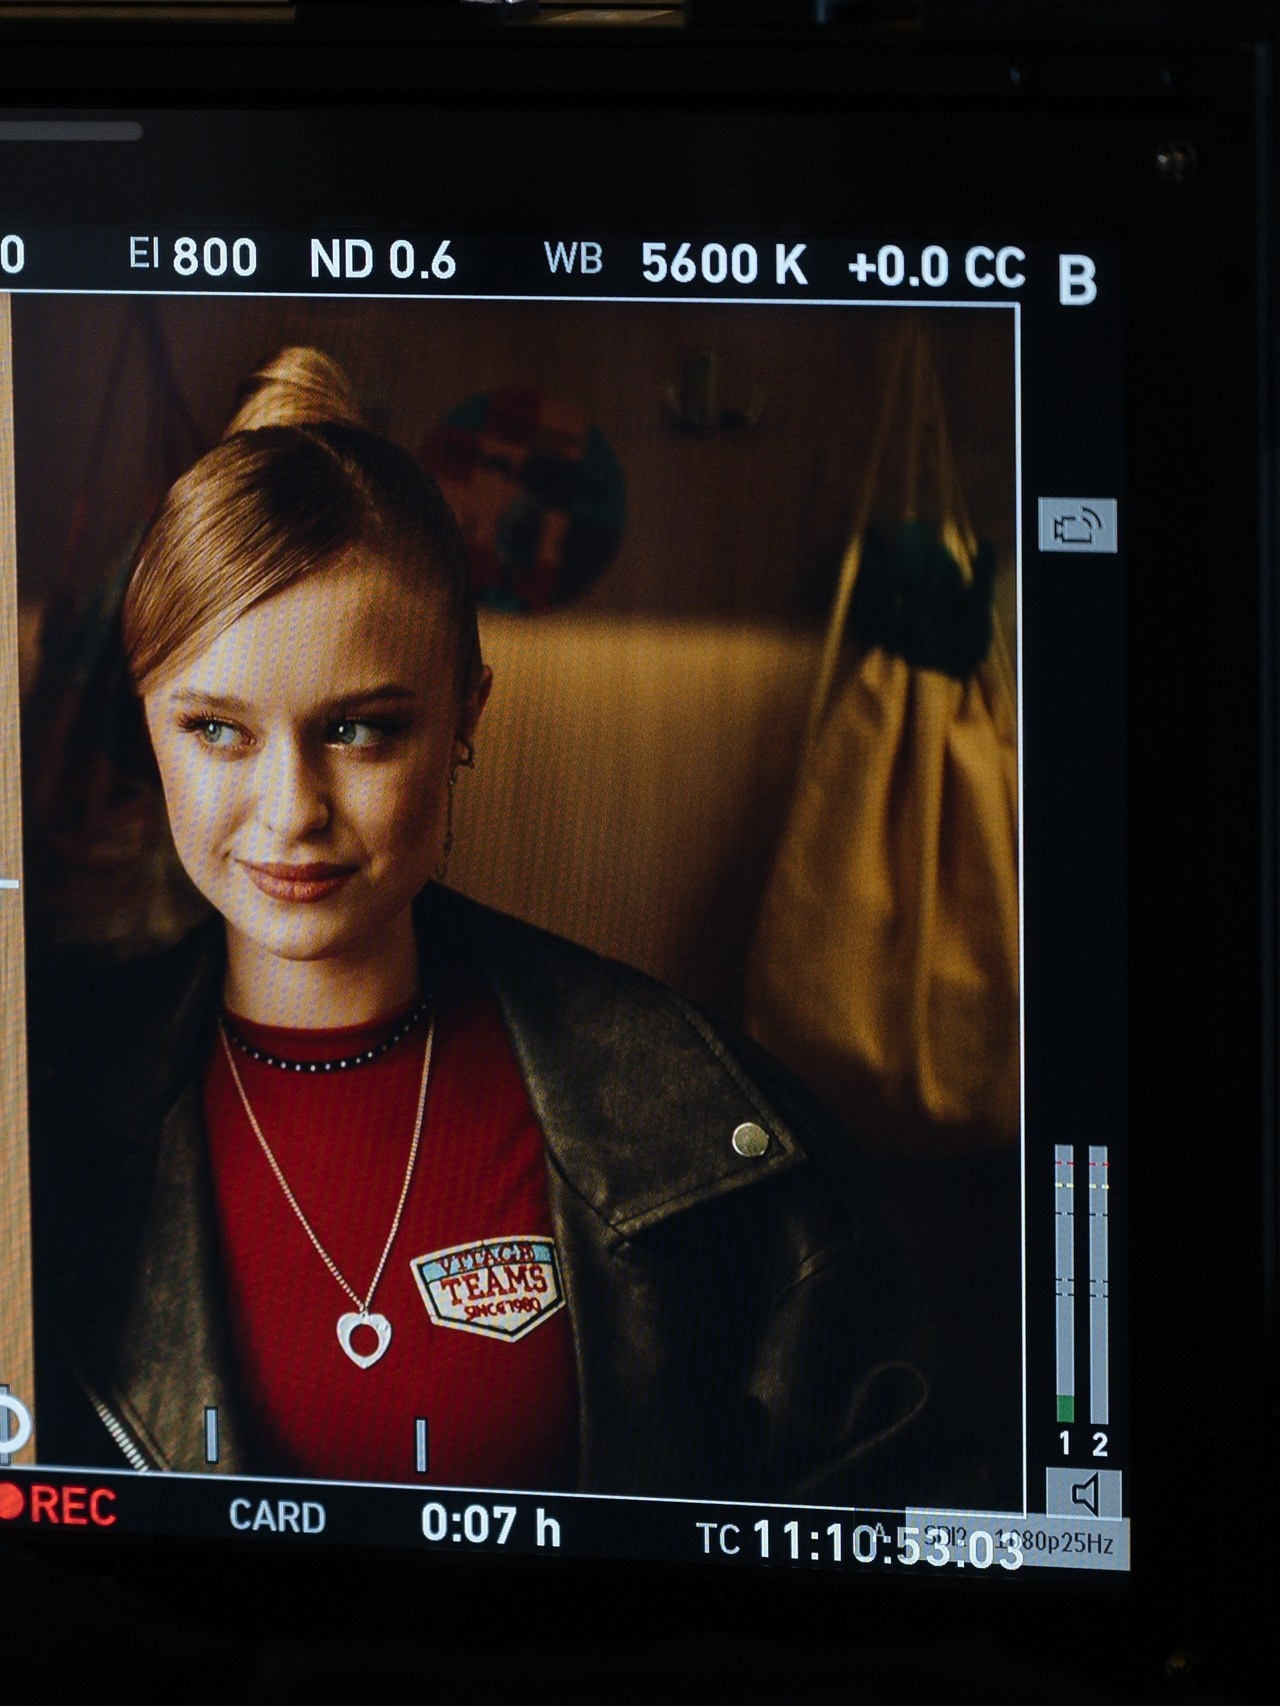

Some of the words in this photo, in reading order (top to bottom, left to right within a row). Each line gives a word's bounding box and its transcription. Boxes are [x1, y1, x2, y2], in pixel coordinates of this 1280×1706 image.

[130, 237, 158, 267] EI
[174, 237, 256, 276] 800
[311, 239, 373, 278] ND
[390, 240, 456, 279] 0.6
[544, 241, 602, 273] WB
[643, 242, 757, 283] 5600
[776, 244, 808, 284] K
[849, 245, 948, 287] +0.0
[965, 246, 1025, 288] CC
[1059, 254, 1097, 305] B
[440, 1264, 548, 1306] TEAMS
[1060, 1431, 1069, 1455] 1
[1093, 1432, 1107, 1456] 2
[31, 1484, 116, 1526] REC
[230, 1499, 325, 1533] CARD
[422, 1503, 516, 1544] 0:07
[537, 1508, 560, 1547] h
[696, 1522, 740, 1554] TC
